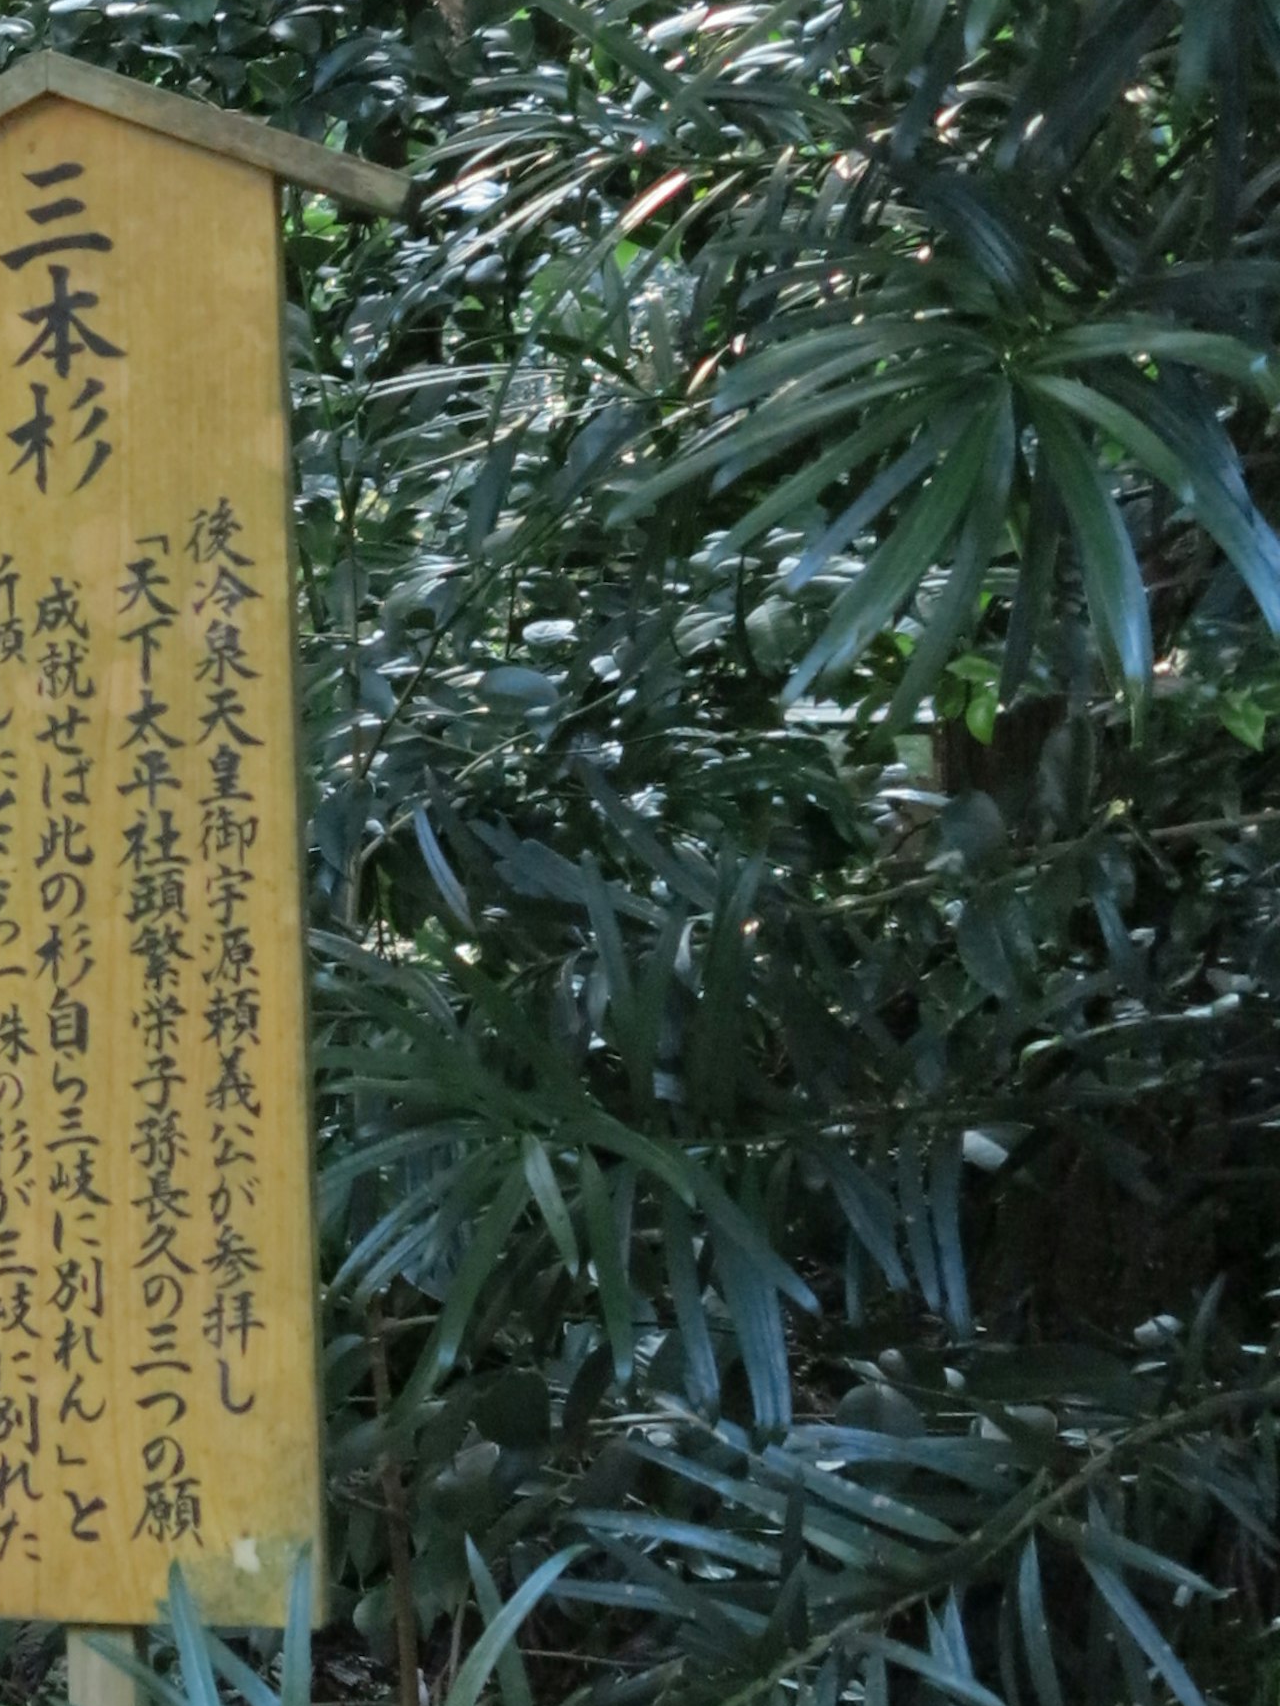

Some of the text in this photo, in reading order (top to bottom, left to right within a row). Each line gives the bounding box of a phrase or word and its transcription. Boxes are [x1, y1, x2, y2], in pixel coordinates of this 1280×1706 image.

[184, 496, 266, 1416] 後冷泉天皇御宇源頼義公が参拝し
